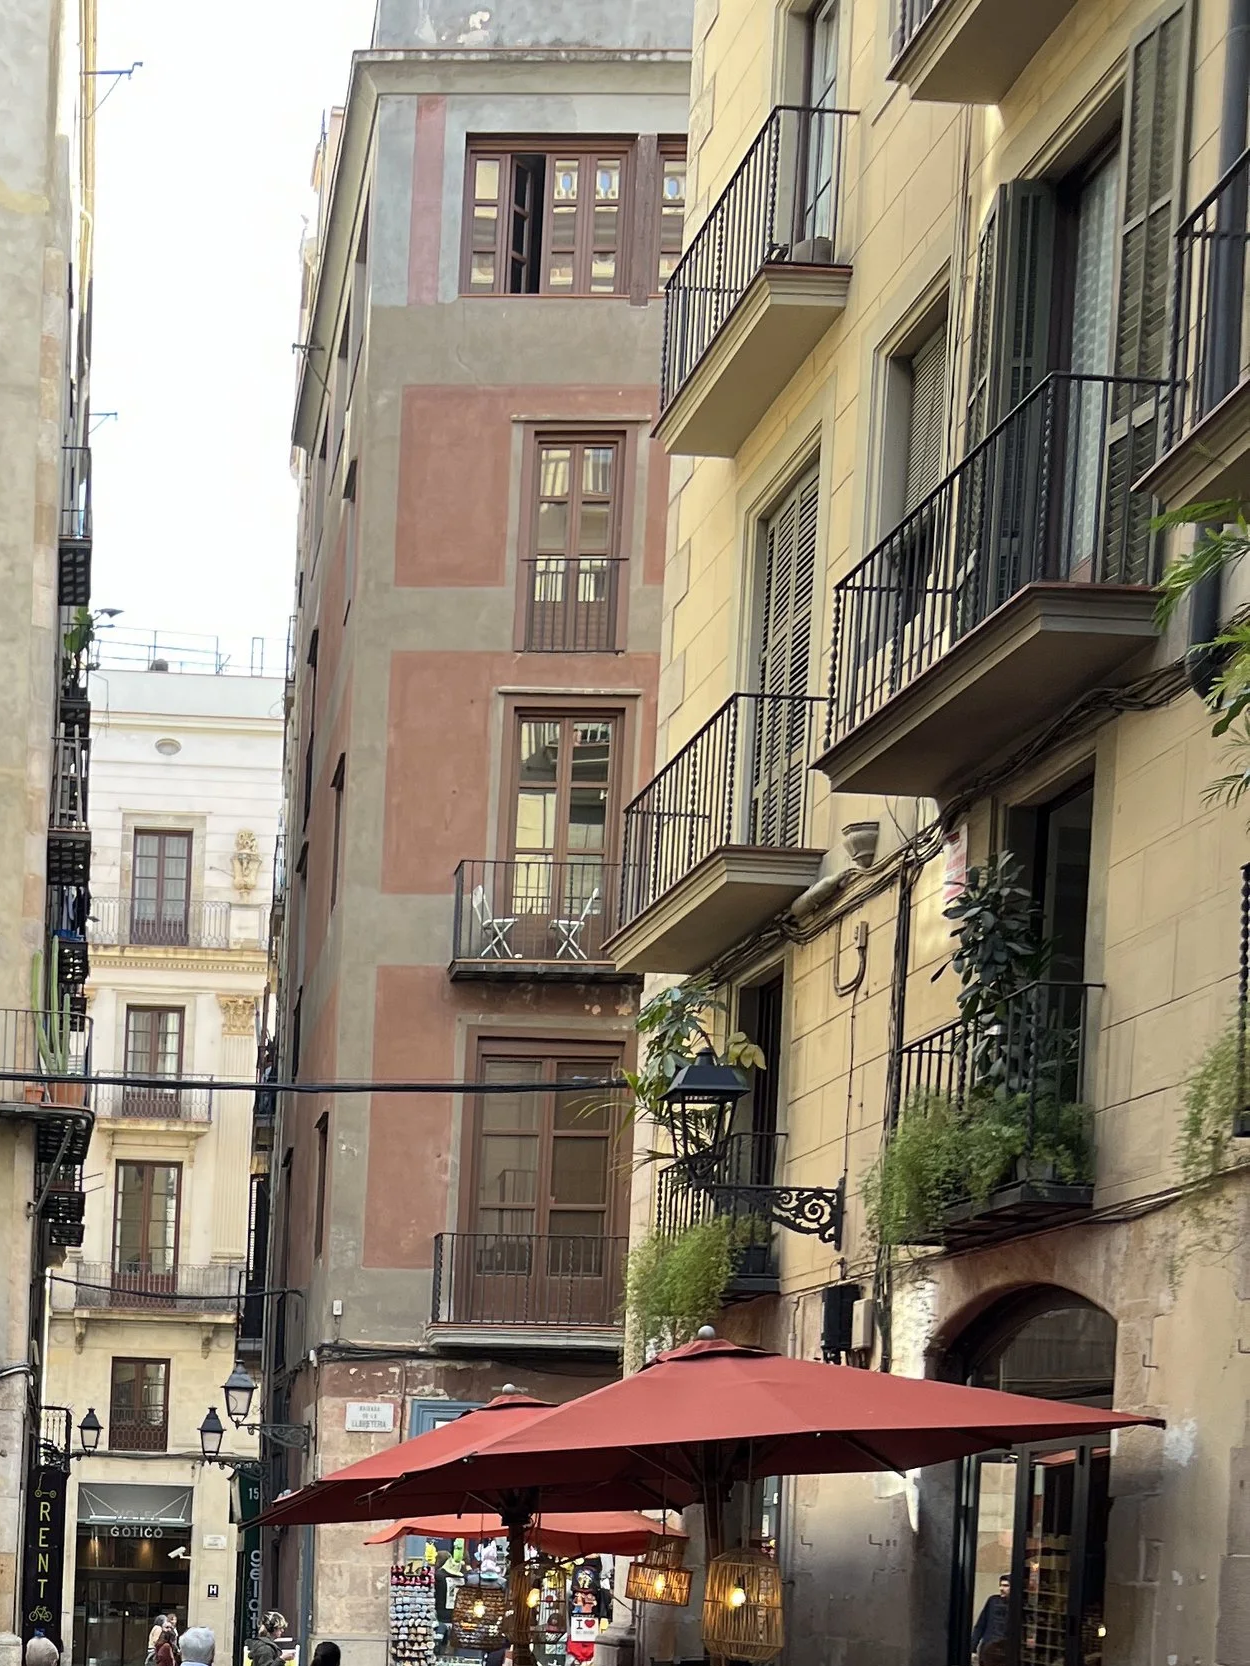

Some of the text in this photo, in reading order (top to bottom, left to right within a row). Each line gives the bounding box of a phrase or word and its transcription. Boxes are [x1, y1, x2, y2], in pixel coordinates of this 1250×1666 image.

[248, 1487, 260, 1500] 15
[36, 1501, 52, 1599] RENT
[209, 1585, 217, 1595] H
